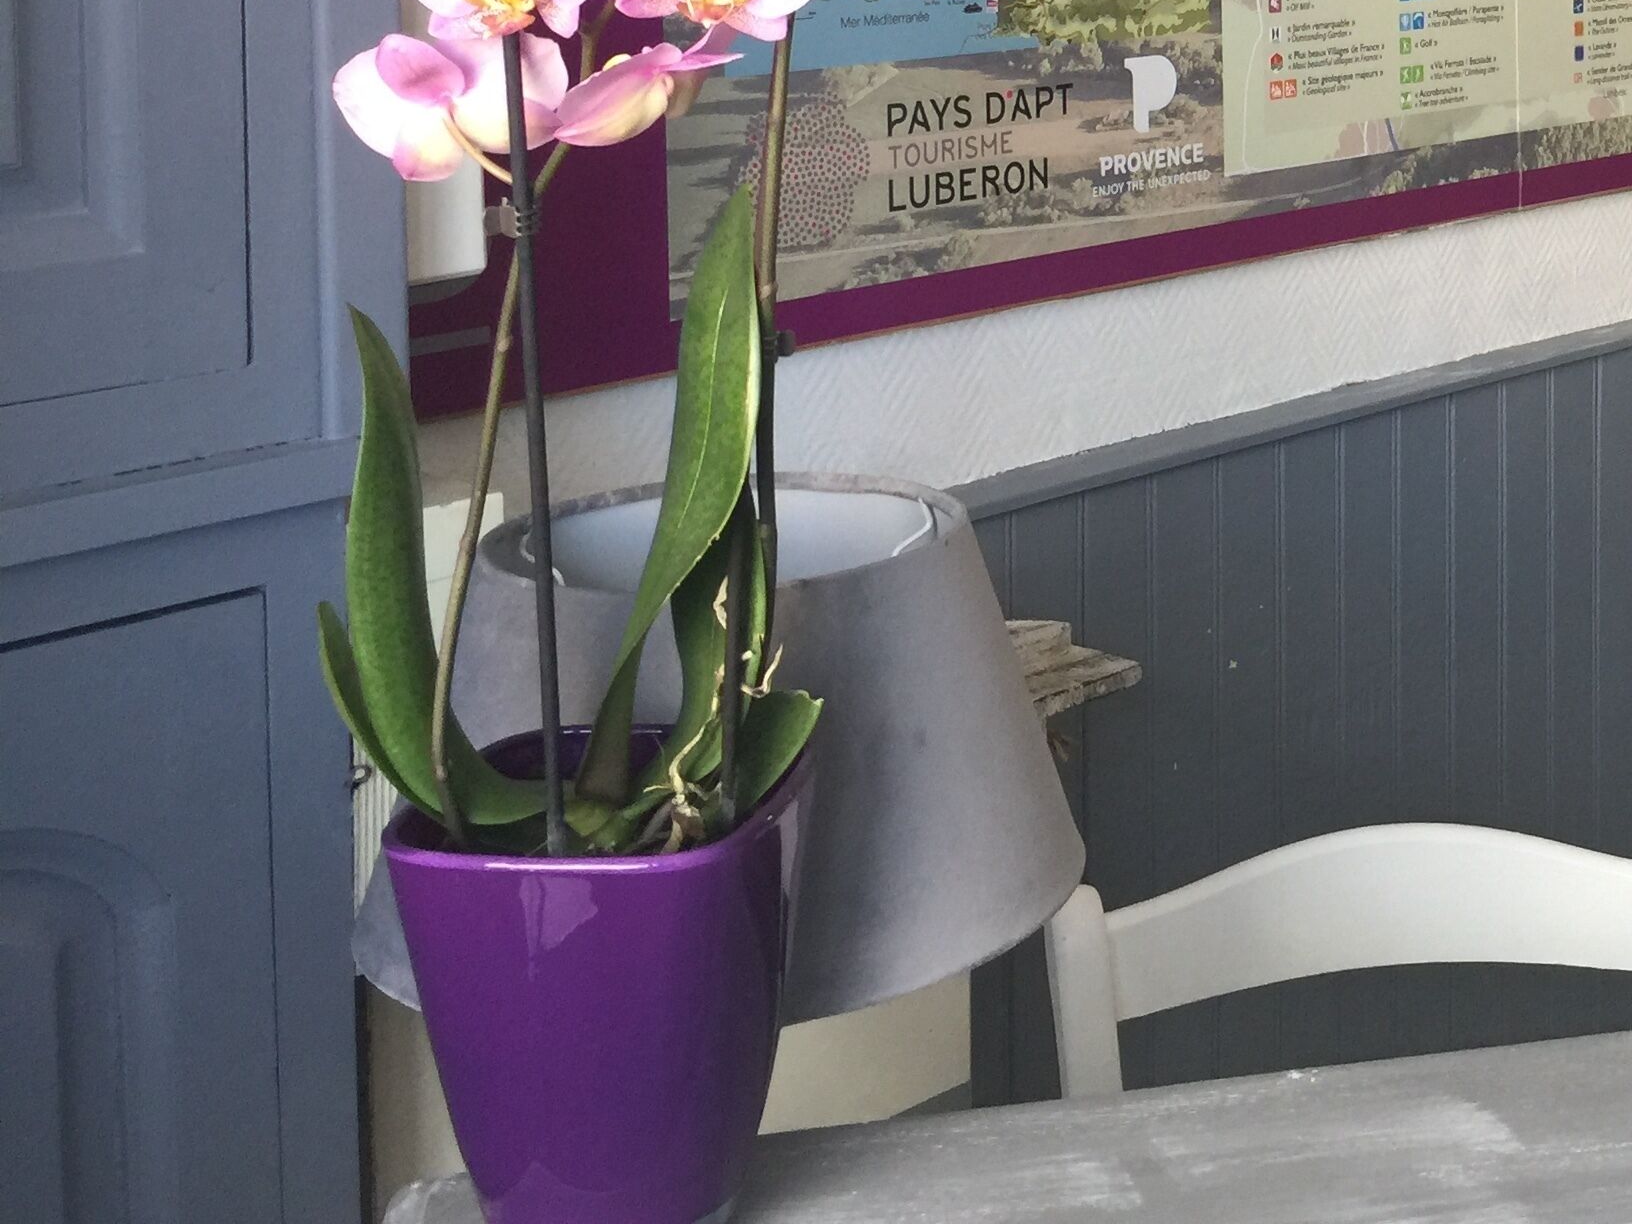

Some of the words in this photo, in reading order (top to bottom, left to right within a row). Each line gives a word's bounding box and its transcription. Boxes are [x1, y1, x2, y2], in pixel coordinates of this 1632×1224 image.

[887, 93, 972, 137] PAYS
[888, 130, 1014, 170] TOURISME
[1100, 142, 1204, 177] PROVENCE
[888, 156, 1049, 213] LUBERON
[1092, 180, 1124, 199] ENJOY
[1126, 179, 1146, 194] THE
